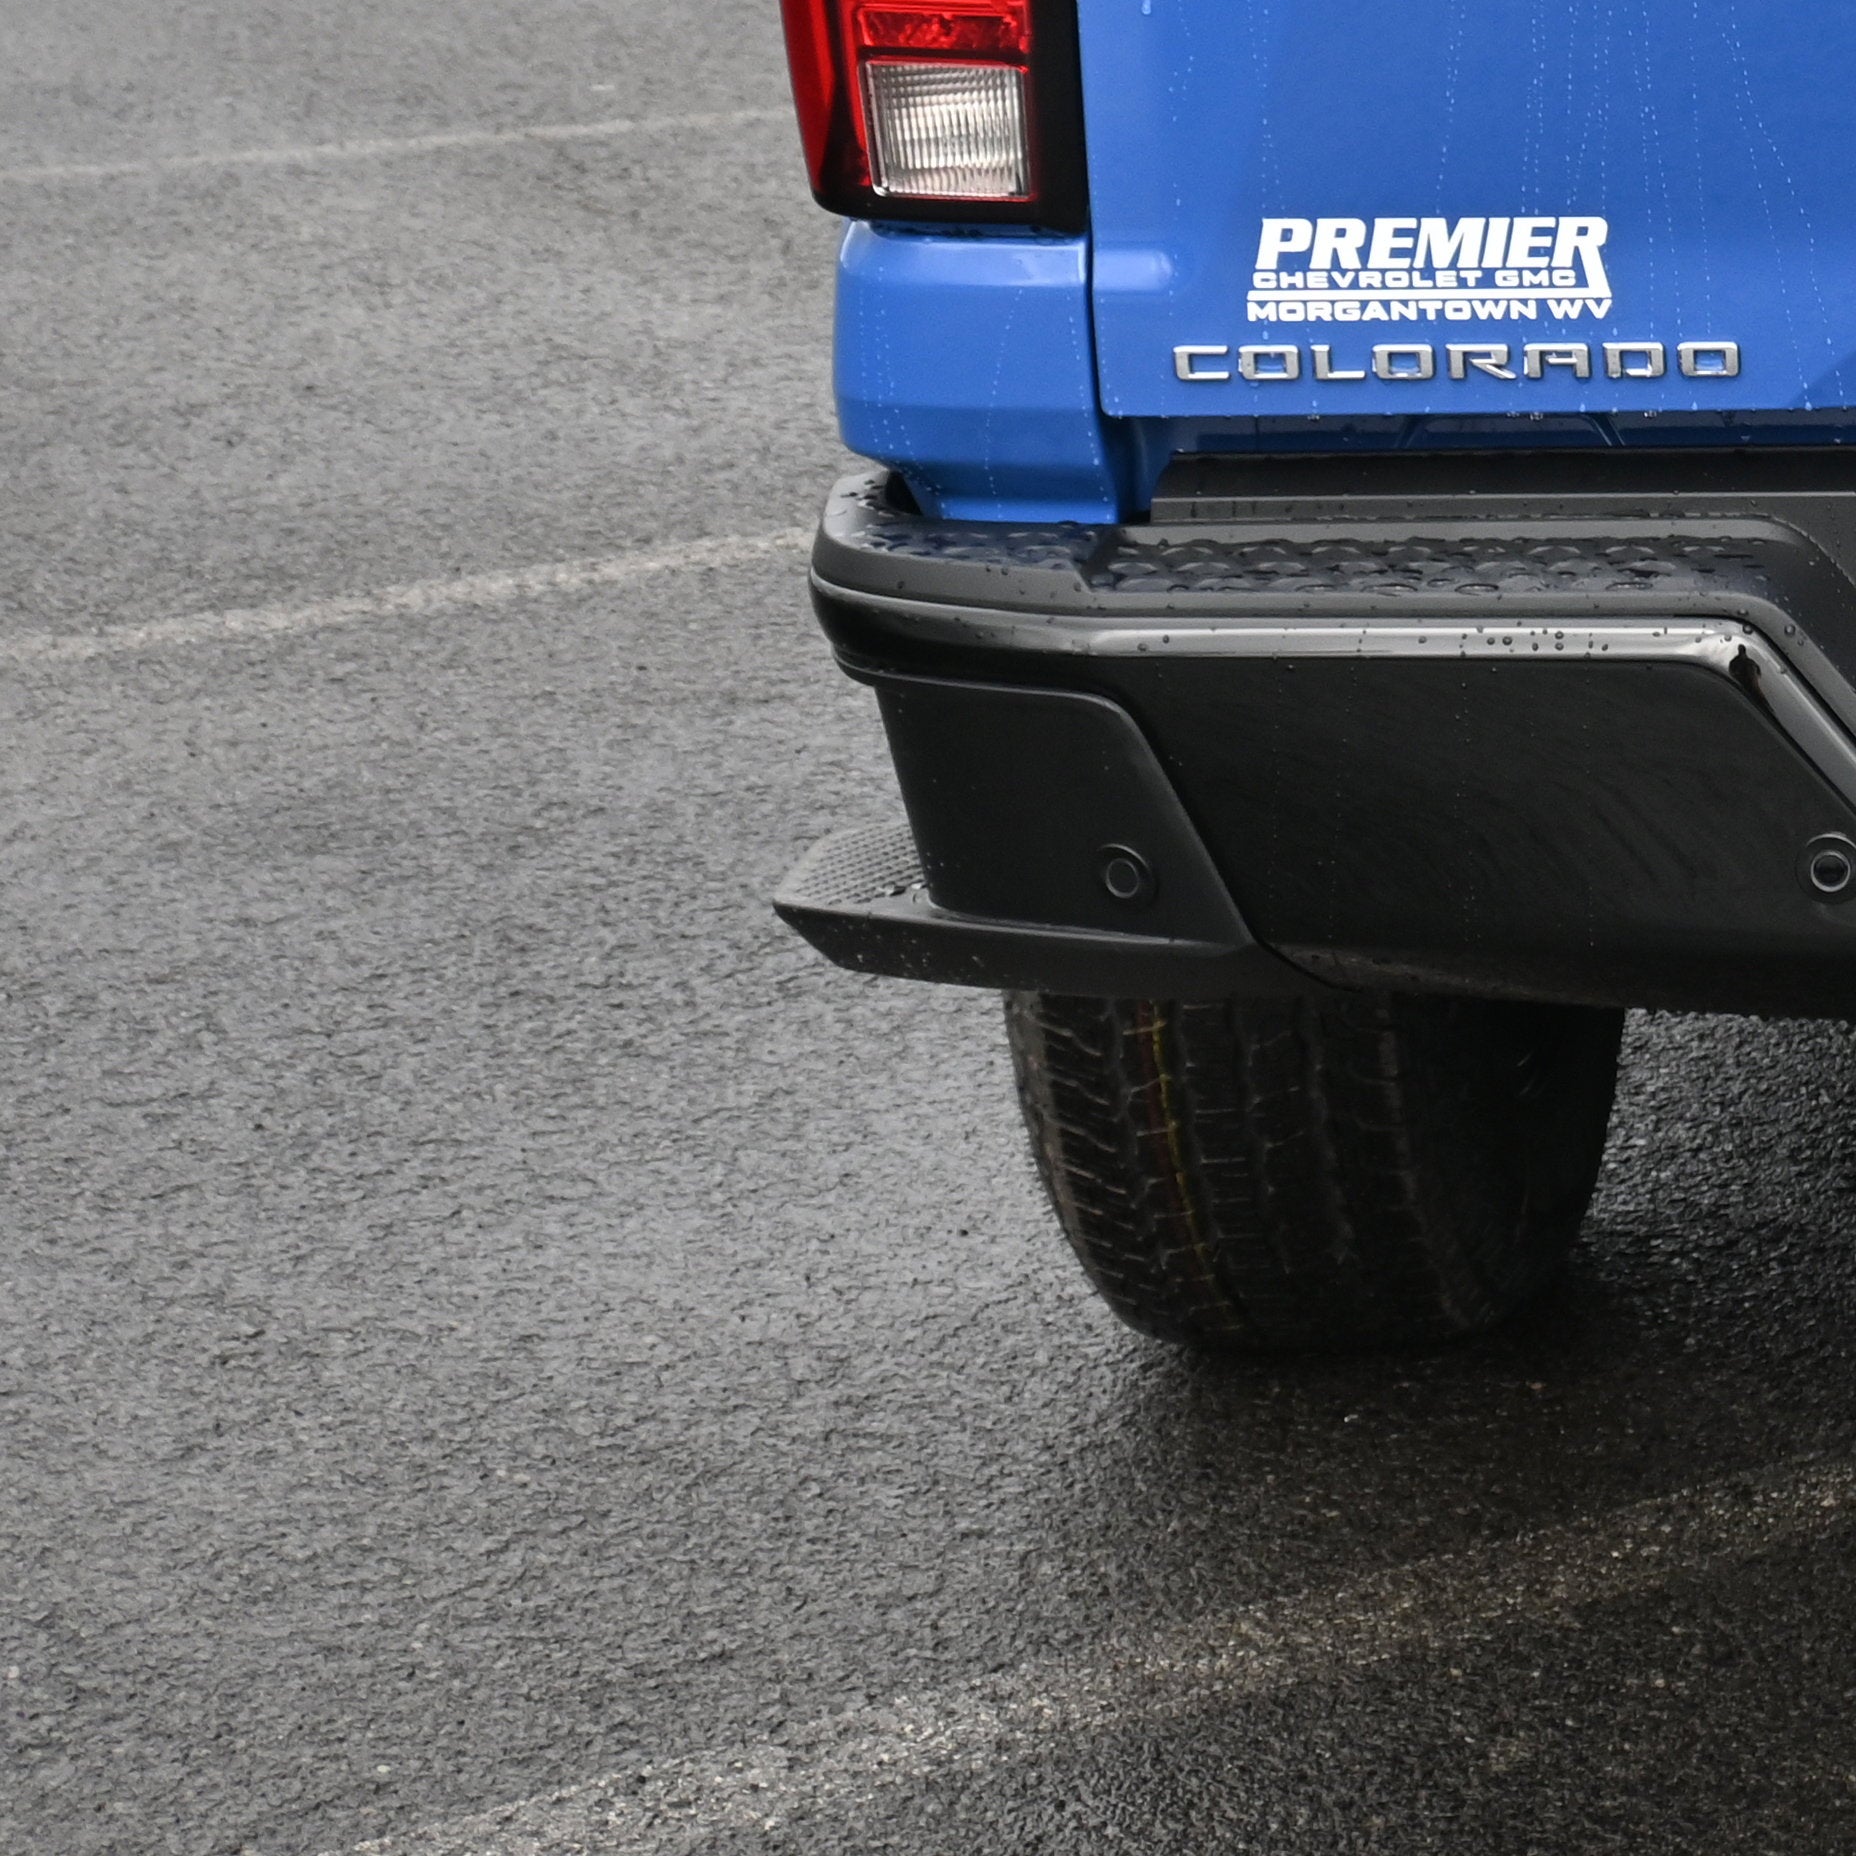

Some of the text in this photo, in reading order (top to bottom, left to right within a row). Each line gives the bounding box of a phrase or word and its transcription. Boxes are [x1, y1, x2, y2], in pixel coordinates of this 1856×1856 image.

[1254, 216, 1609, 271] PREMIER
[1253, 269, 1577, 290] CHEVROLET GMC
[1246, 298, 1613, 322] MORGANTOWN WV
[1172, 341, 1742, 382] COLORADO
